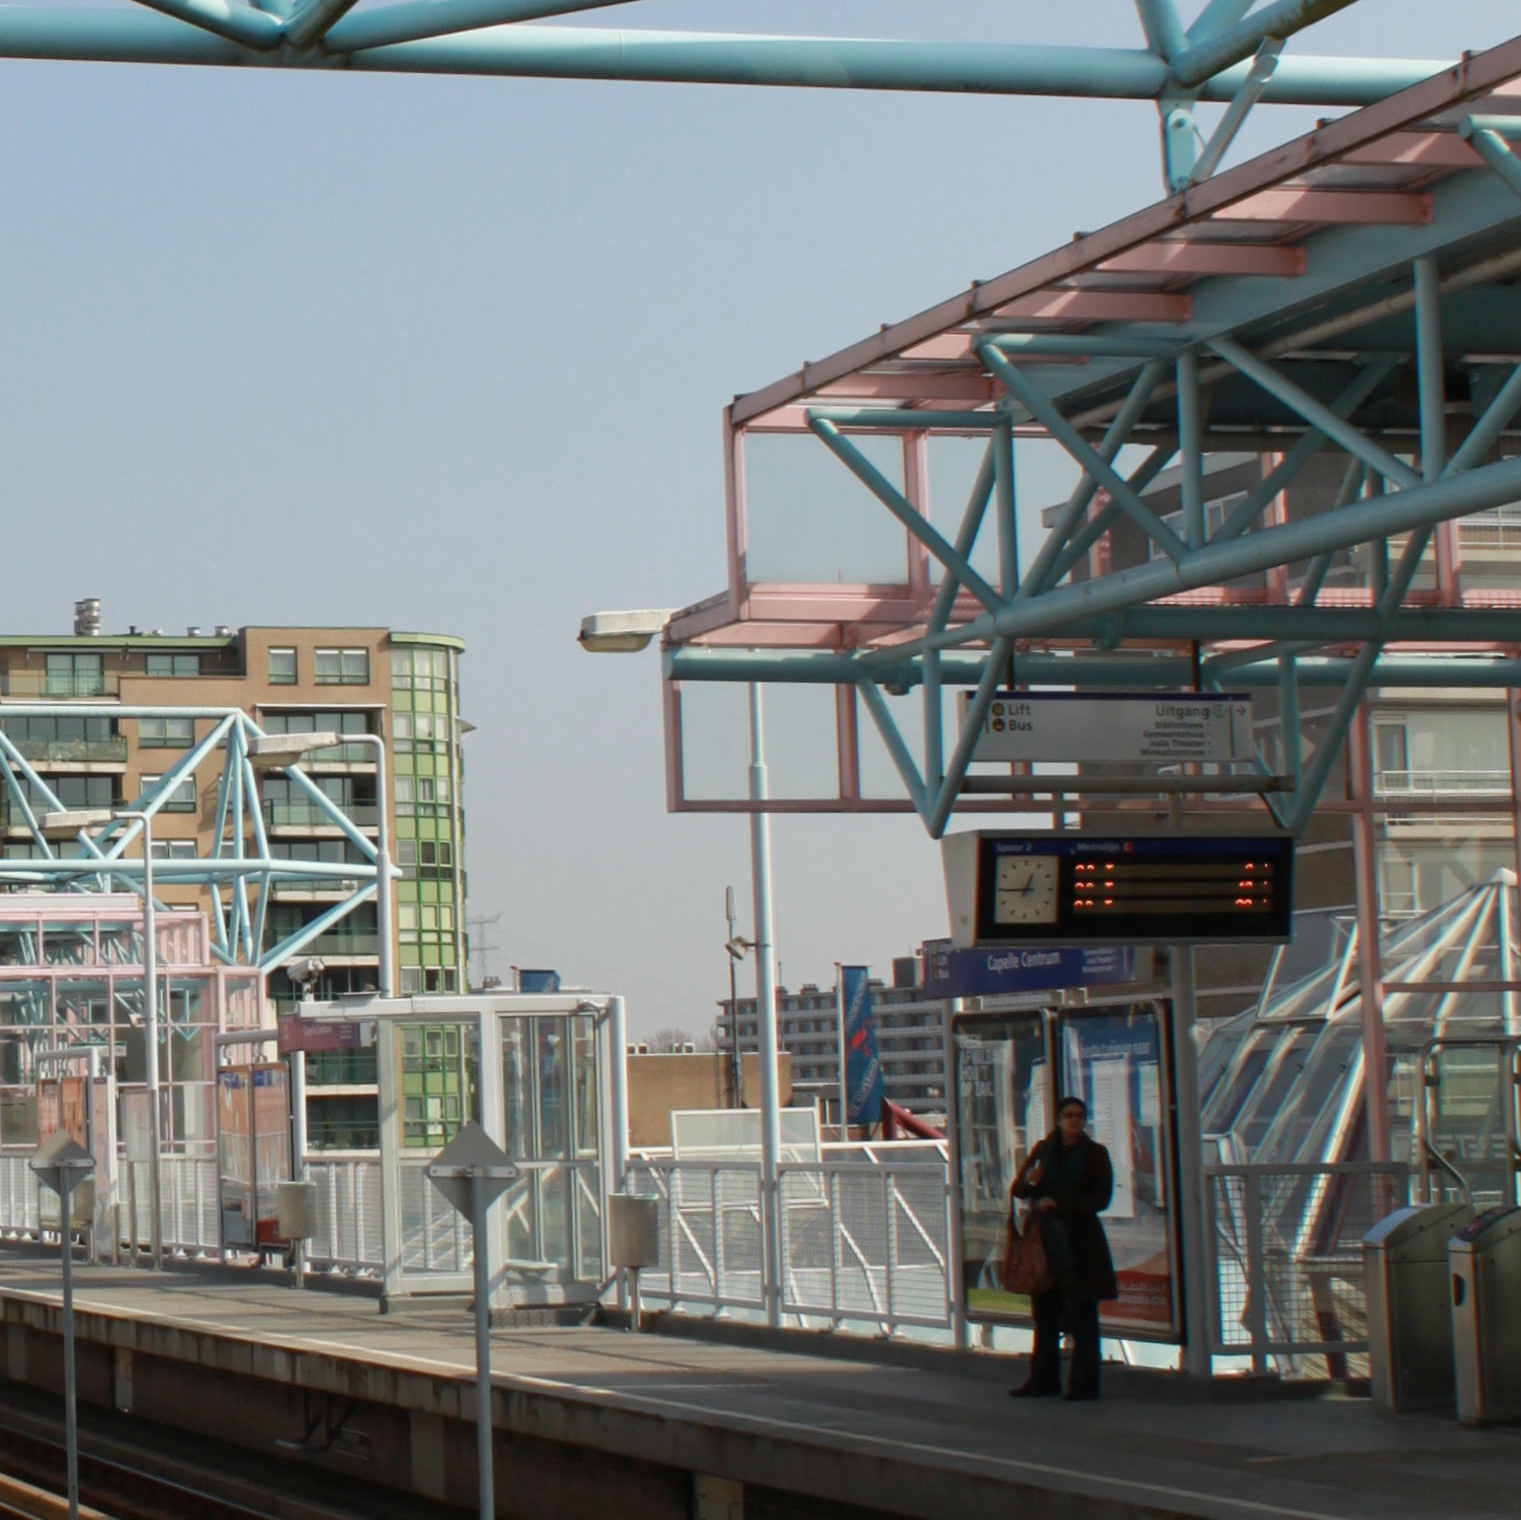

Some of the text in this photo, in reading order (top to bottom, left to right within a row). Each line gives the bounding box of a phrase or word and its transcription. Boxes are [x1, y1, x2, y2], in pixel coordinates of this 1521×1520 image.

[1008, 704, 1032, 716] Lift
[1155, 705, 1210, 719] Uitgang
[1008, 719, 1032, 731] Bus
[987, 952, 1020, 973] Capelle
[1020, 951, 1061, 968] Centrum
